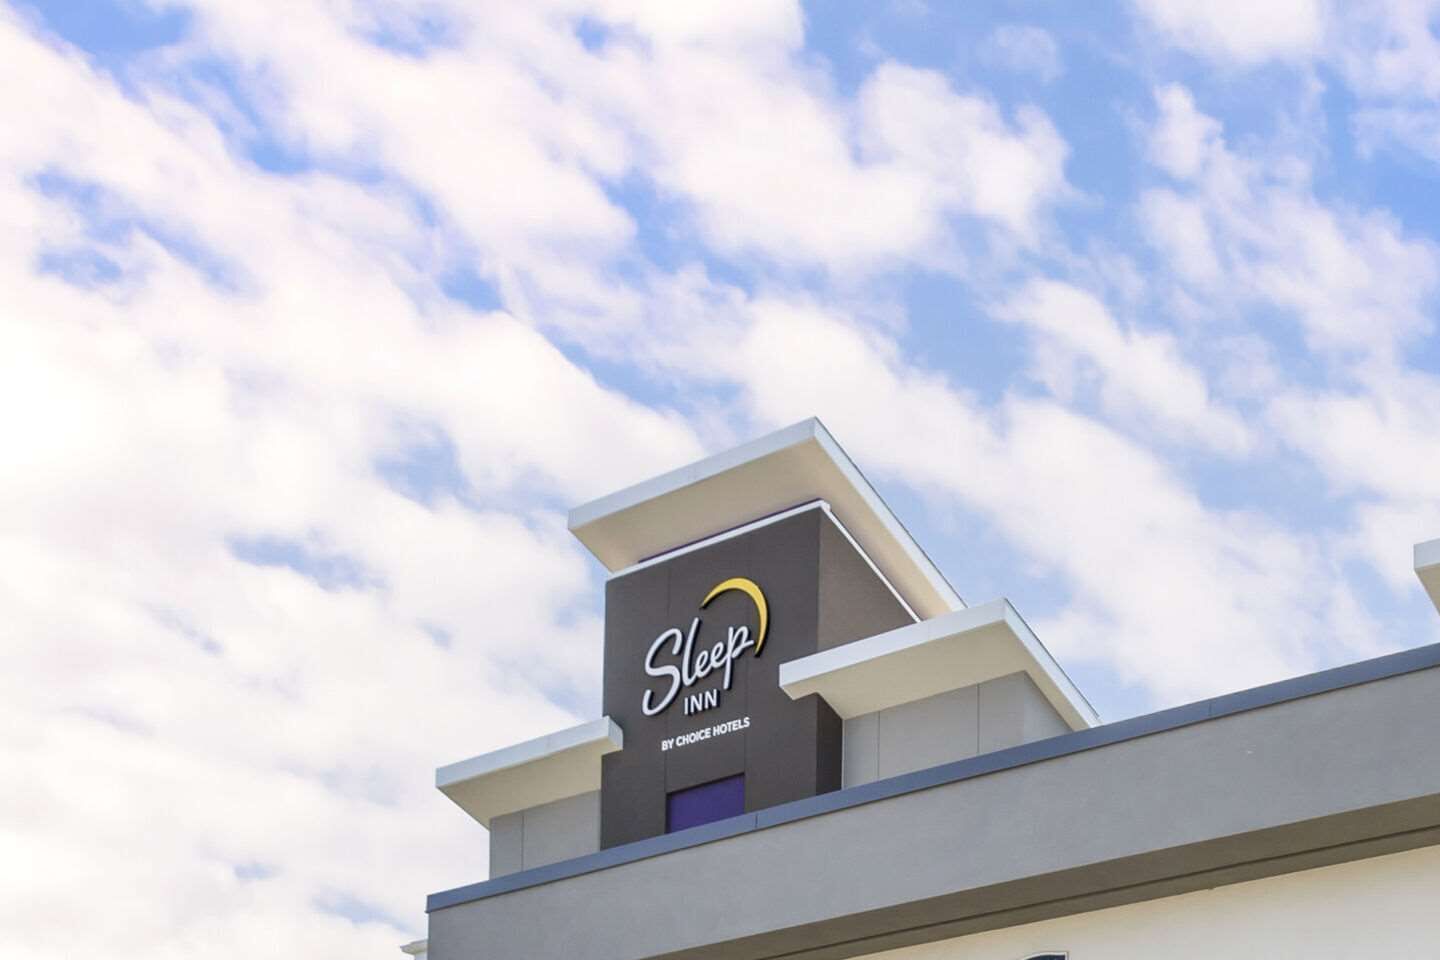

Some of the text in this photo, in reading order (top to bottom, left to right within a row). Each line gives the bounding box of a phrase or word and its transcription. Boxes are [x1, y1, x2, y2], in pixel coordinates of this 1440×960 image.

[642, 617, 754, 716] Sleep
[684, 689, 718, 715] INN
[661, 717, 750, 751] BY CHOICE HOTELS
